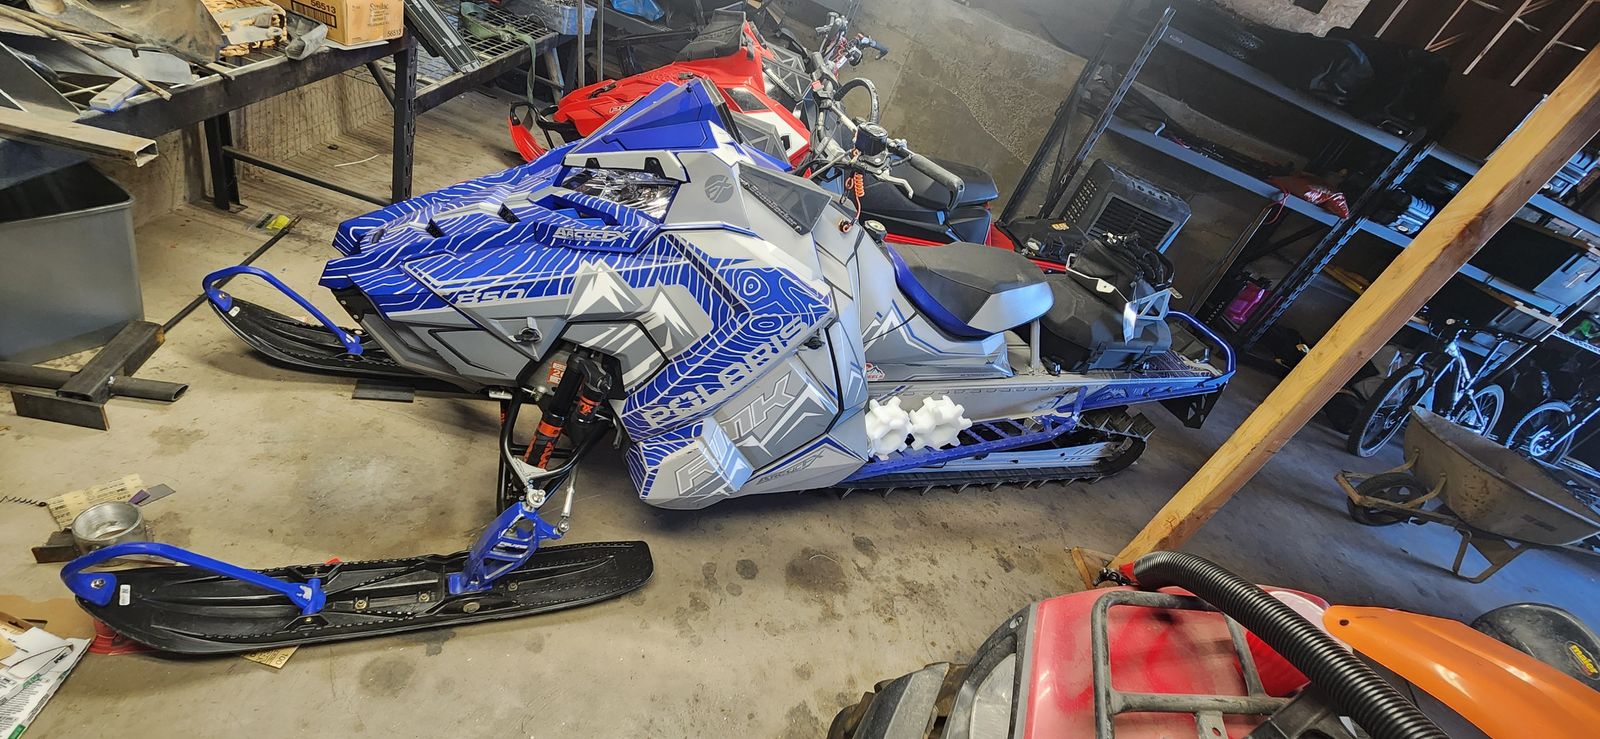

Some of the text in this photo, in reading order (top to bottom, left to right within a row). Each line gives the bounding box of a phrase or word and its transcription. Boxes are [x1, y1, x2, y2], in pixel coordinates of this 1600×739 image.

[311, 0, 336, 14] 56513
[454, 288, 526, 307] 850
[643, 315, 809, 428] POLARIS
